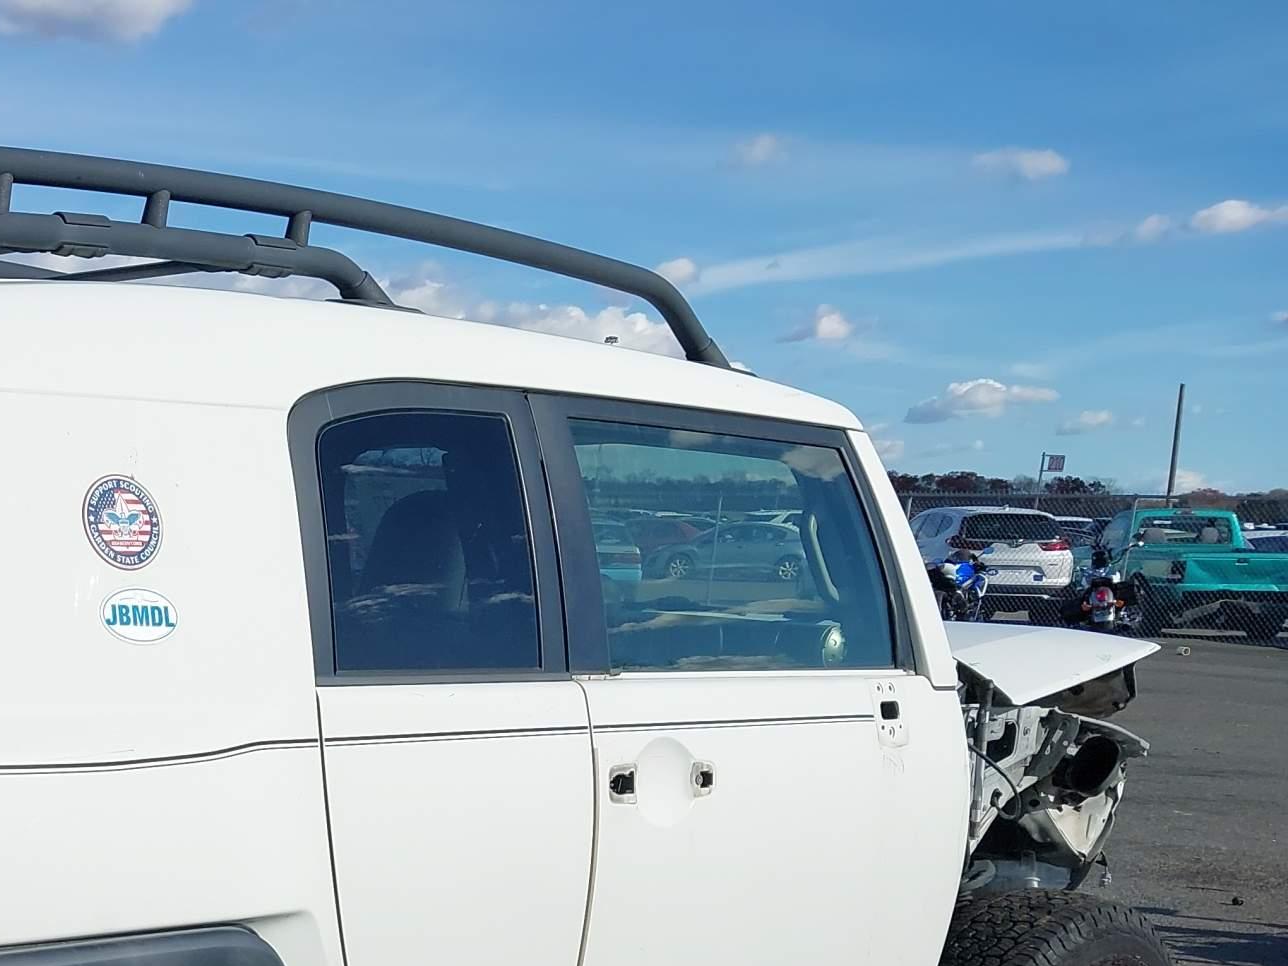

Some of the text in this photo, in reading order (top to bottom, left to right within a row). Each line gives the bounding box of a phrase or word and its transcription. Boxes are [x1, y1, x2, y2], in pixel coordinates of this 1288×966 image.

[89, 480, 118, 506] SUPPORT
[119, 480, 155, 514] SCOUTING
[90, 524, 160, 565] GARDEN STATE COUNCIL
[105, 604, 177, 628] JBMDL
